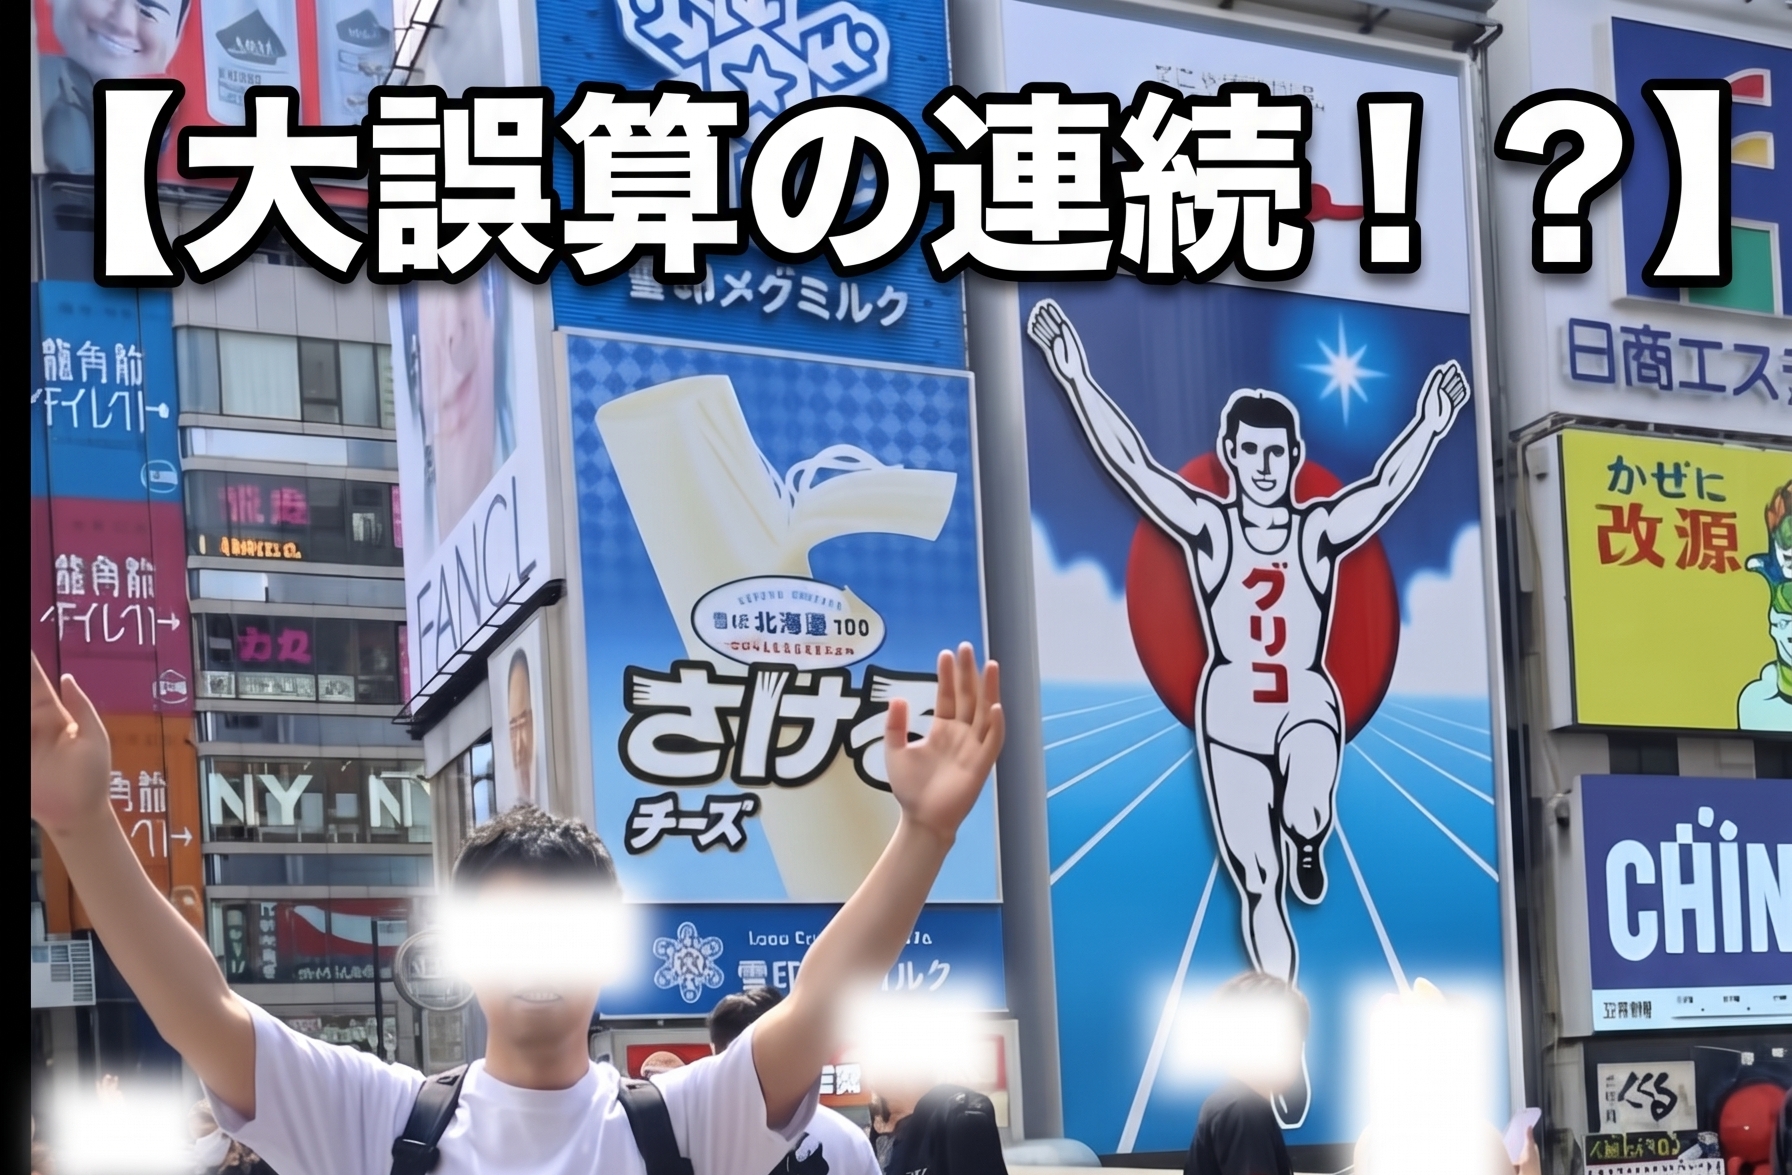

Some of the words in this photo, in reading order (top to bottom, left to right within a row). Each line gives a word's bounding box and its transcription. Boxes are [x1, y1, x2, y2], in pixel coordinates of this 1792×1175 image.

[1607, 455, 1726, 502] かぜに
[1596, 502, 1742, 573] 改源
[416, 475, 537, 689] FANCL
[1241, 561, 1289, 704] グリコ
[209, 772, 313, 826] NY
[625, 792, 761, 855] チーズ
